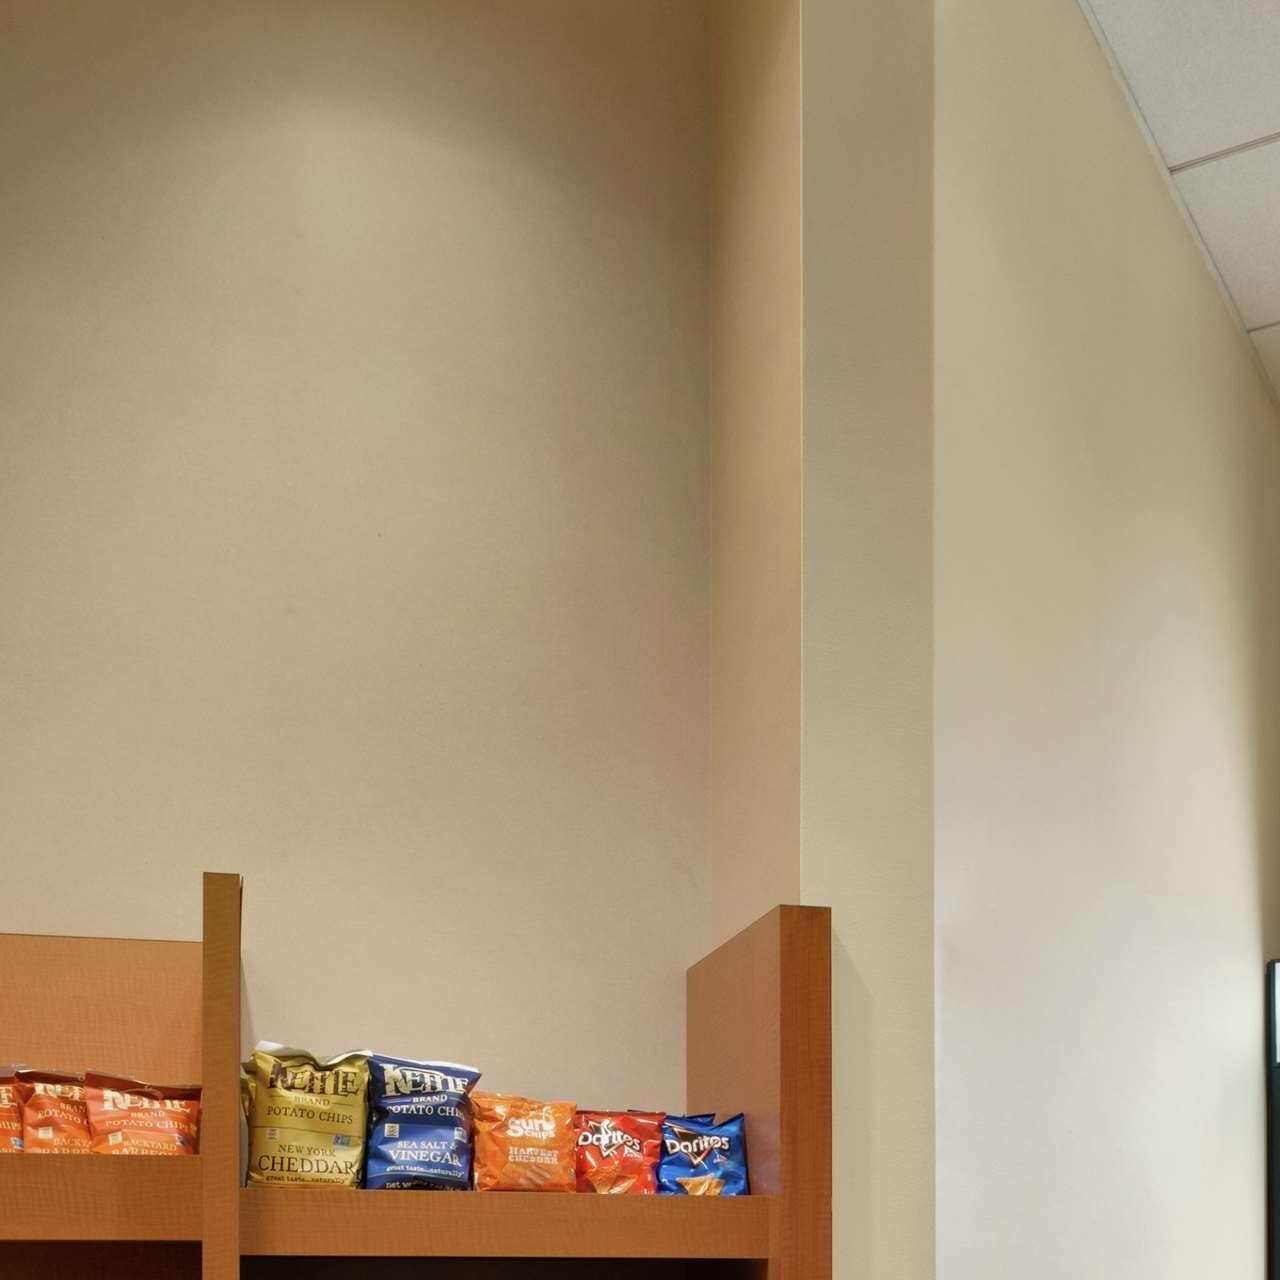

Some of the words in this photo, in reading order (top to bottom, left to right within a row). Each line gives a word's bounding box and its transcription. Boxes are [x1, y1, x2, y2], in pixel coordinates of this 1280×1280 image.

[379, 1063, 468, 1097] KETTLE
[294, 1095, 330, 1107] BRAND
[412, 1094, 448, 1103] BRAND
[266, 1105, 315, 1120] POTATO
[319, 1110, 353, 1125] CHIPS
[106, 1119, 153, 1129] POTATO
[397, 1140, 418, 1149] SEA
[420, 1141, 448, 1149] SALT
[578, 1131, 641, 1151] Doritos
[664, 1135, 730, 1155] Doritos
[278, 1144, 303, 1154] NEW
[307, 1146, 337, 1157] YORK
[508, 1147, 560, 1158] HARVEST
[258, 1155, 356, 1175] CHEDDAR
[389, 1150, 462, 1167] VINEGAR
[508, 1155, 559, 1164] CHEDDAR
